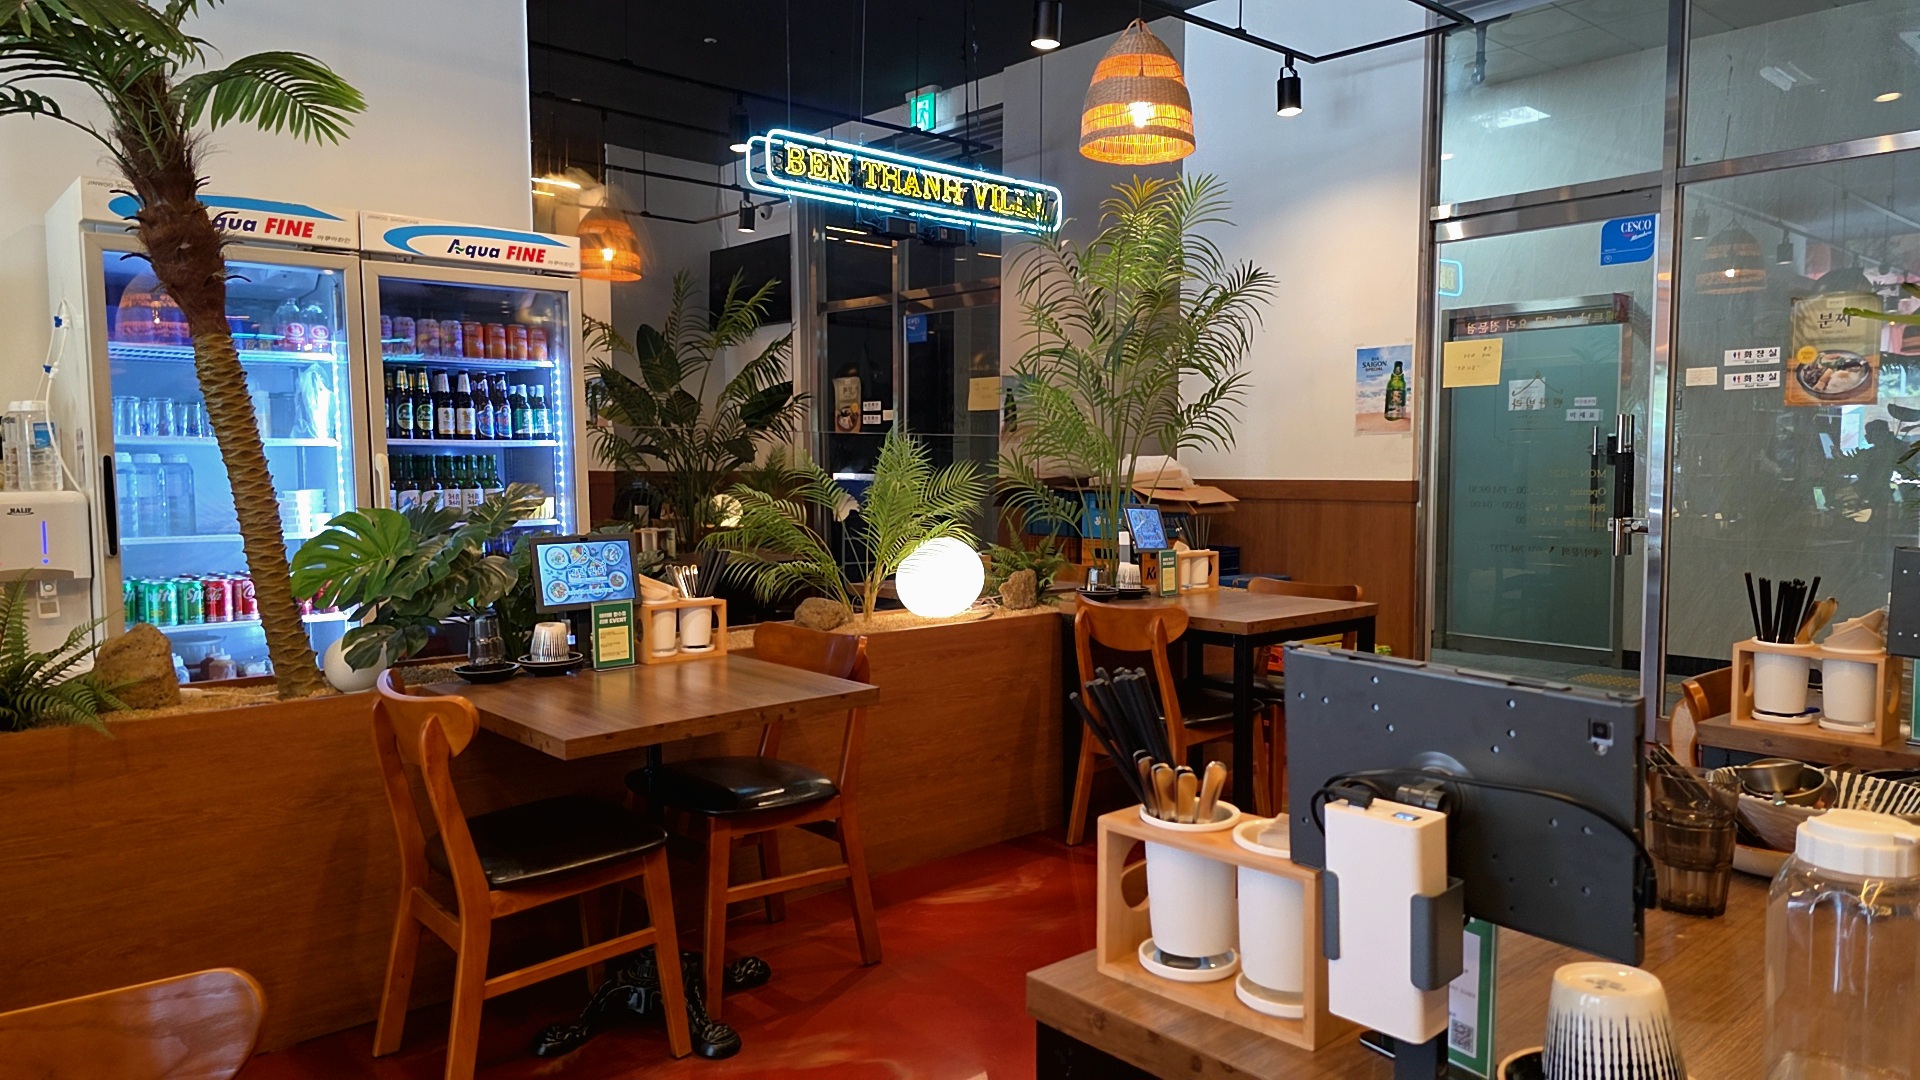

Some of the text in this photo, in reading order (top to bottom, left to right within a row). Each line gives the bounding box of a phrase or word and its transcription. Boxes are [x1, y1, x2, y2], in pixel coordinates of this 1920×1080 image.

[784, 143, 852, 185] BEN
[861, 158, 965, 205] THANH
[212, 215, 315, 238] qua FINE
[1620, 219, 1652, 233] CESCO
[447, 238, 547, 264] Aqua FINE
[1362, 360, 1388, 369] SAIGON
